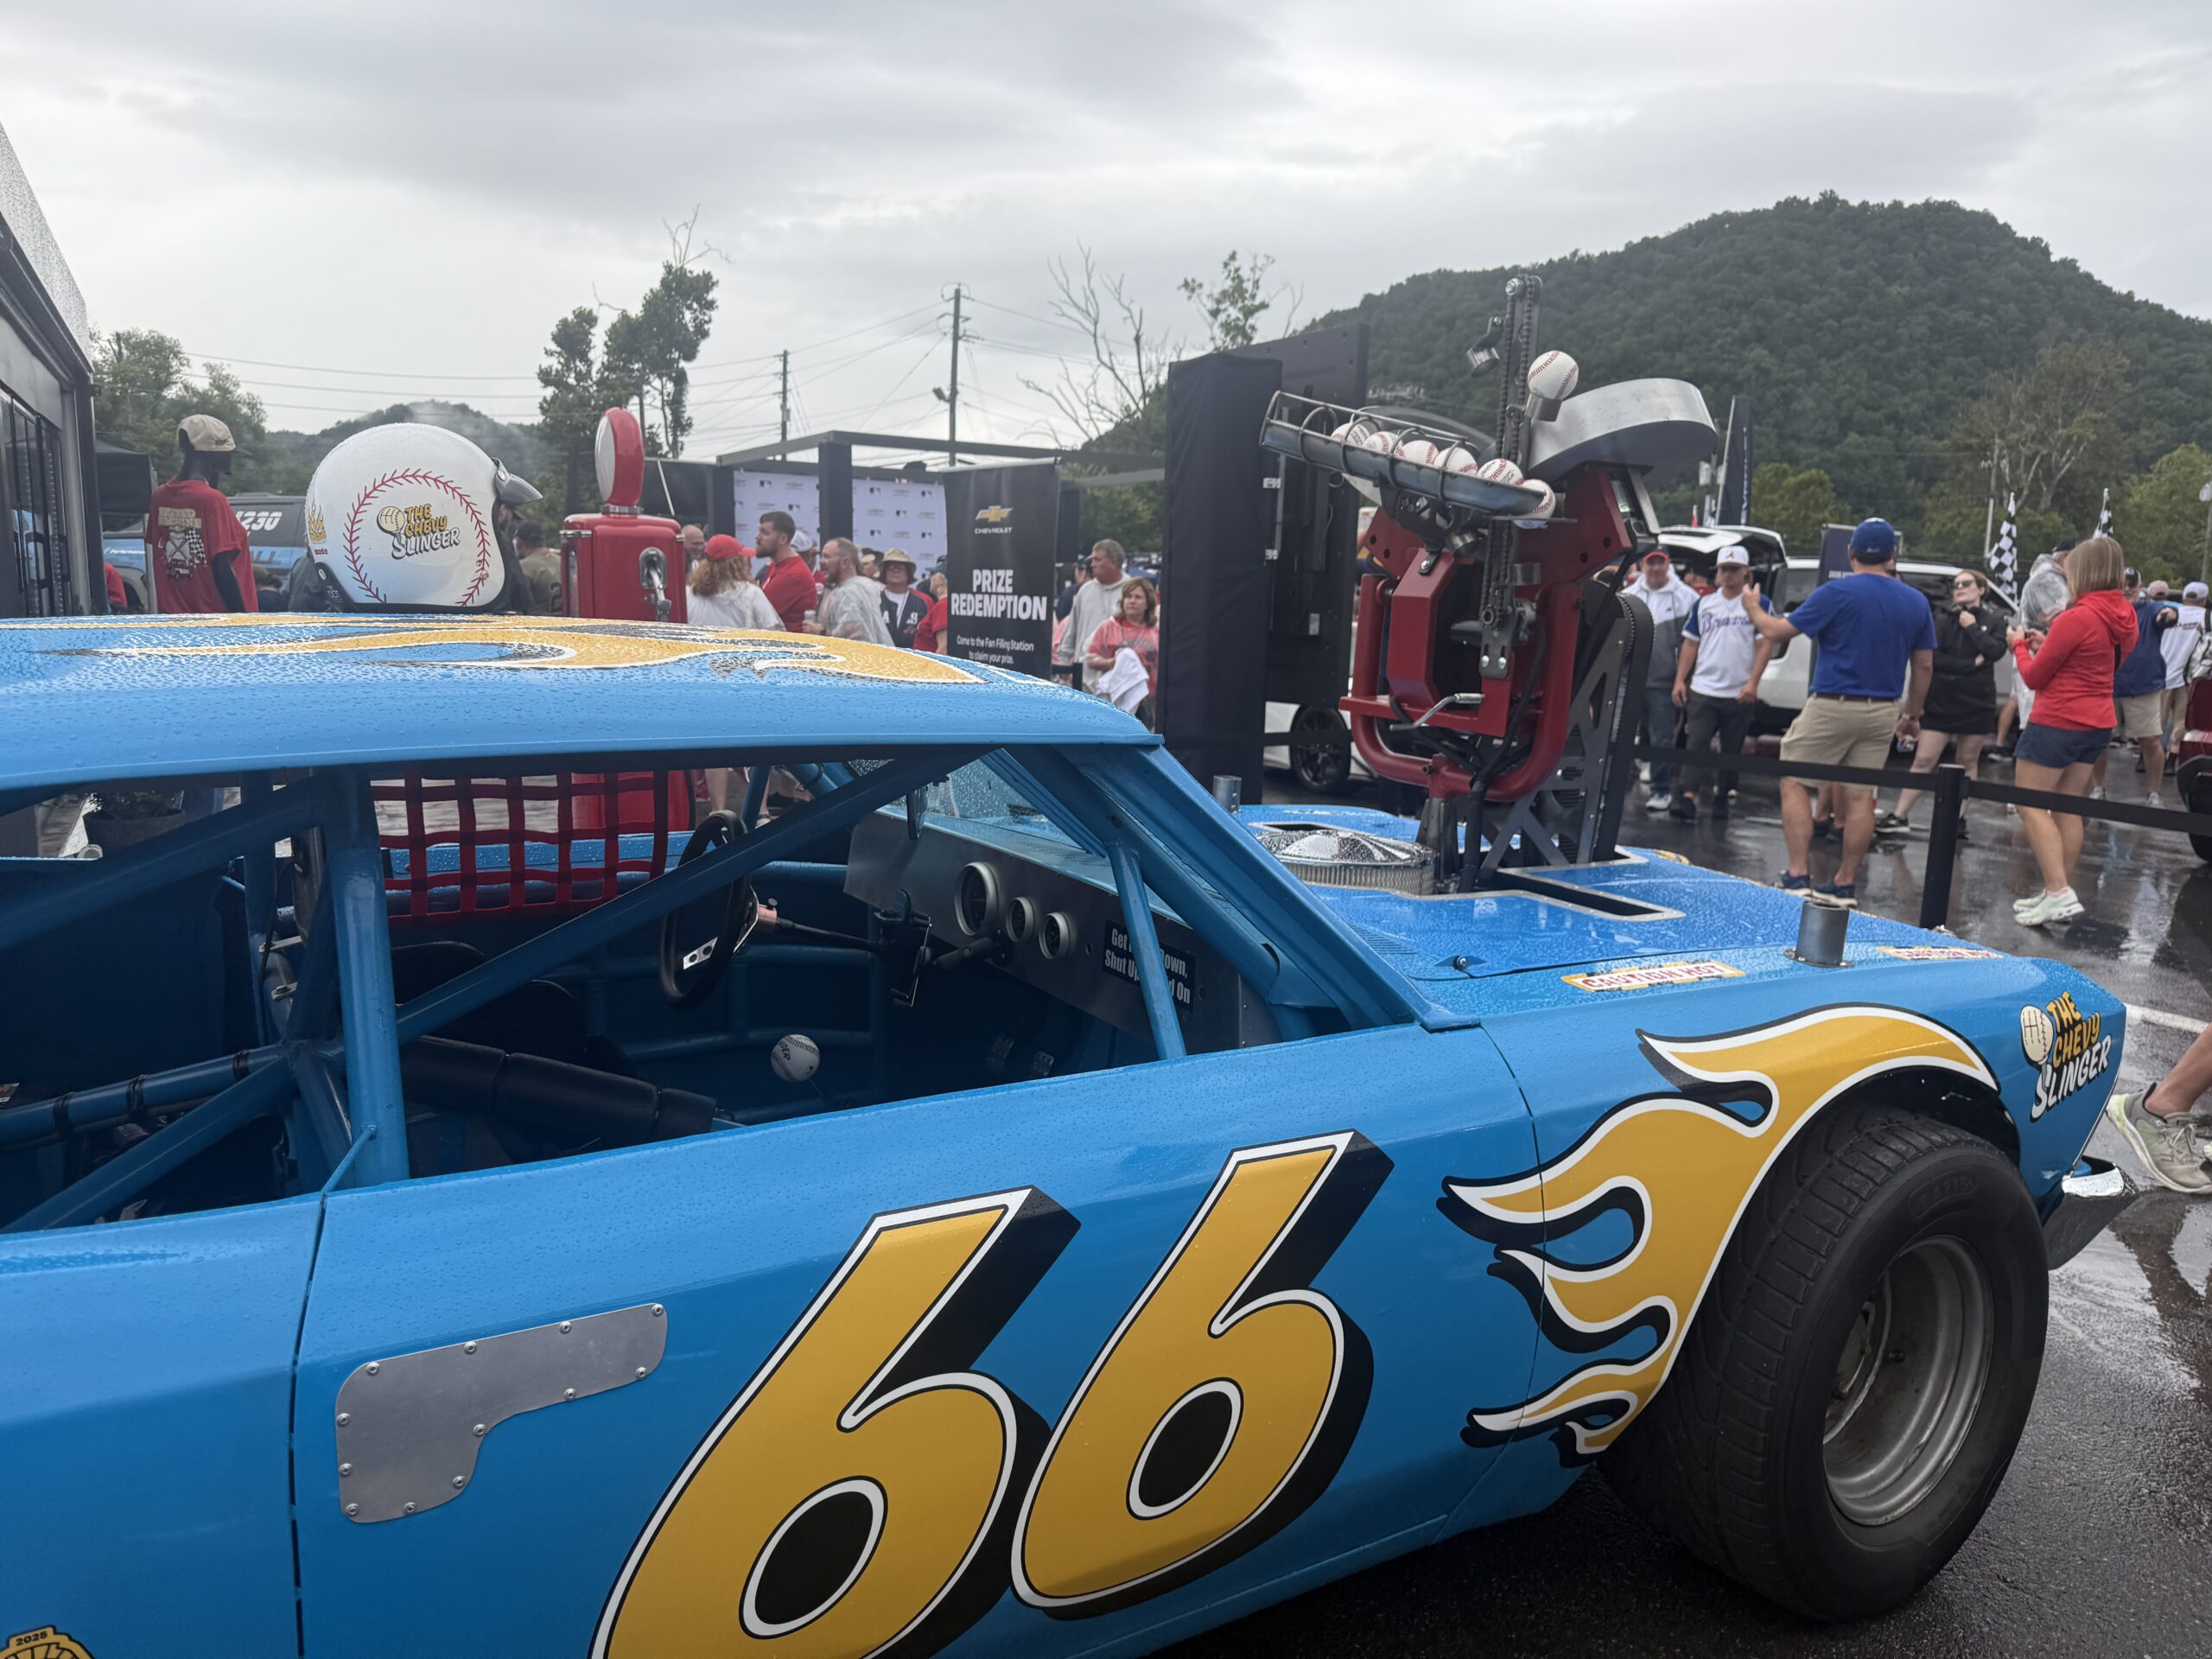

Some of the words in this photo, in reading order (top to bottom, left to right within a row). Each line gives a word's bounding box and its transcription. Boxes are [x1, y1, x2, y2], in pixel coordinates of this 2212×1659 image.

[404, 503, 432, 519] THE
[404, 515, 448, 538] CHEVY
[974, 526, 1013, 535] CHEVROLET
[391, 526, 461, 560] SLINGER
[972, 569, 1014, 594] PRIZE
[950, 592, 1047, 621] REDEMPTION
[957, 635, 969, 646] Come
[976, 637, 985, 647] the
[985, 638, 996, 648] Fan
[995, 638, 1011, 652] Filling
[1010, 639, 1034, 652] Station
[988, 654, 1002, 664] your
[1111, 928, 1128, 950] Get
[1105, 949, 1126, 975] Shut
[1580, 969, 1679, 988] CAUTION
[1679, 964, 1725, 979] HOT
[1176, 981, 1191, 1004] On
[2045, 991, 2082, 1033] THE
[2052, 1012, 2101, 1069] CHEVY
[2031, 1034, 2112, 1121] SLINGER
[589, 1129, 1384, 1659] 66
[16, 1630, 48, 1647] 2025
